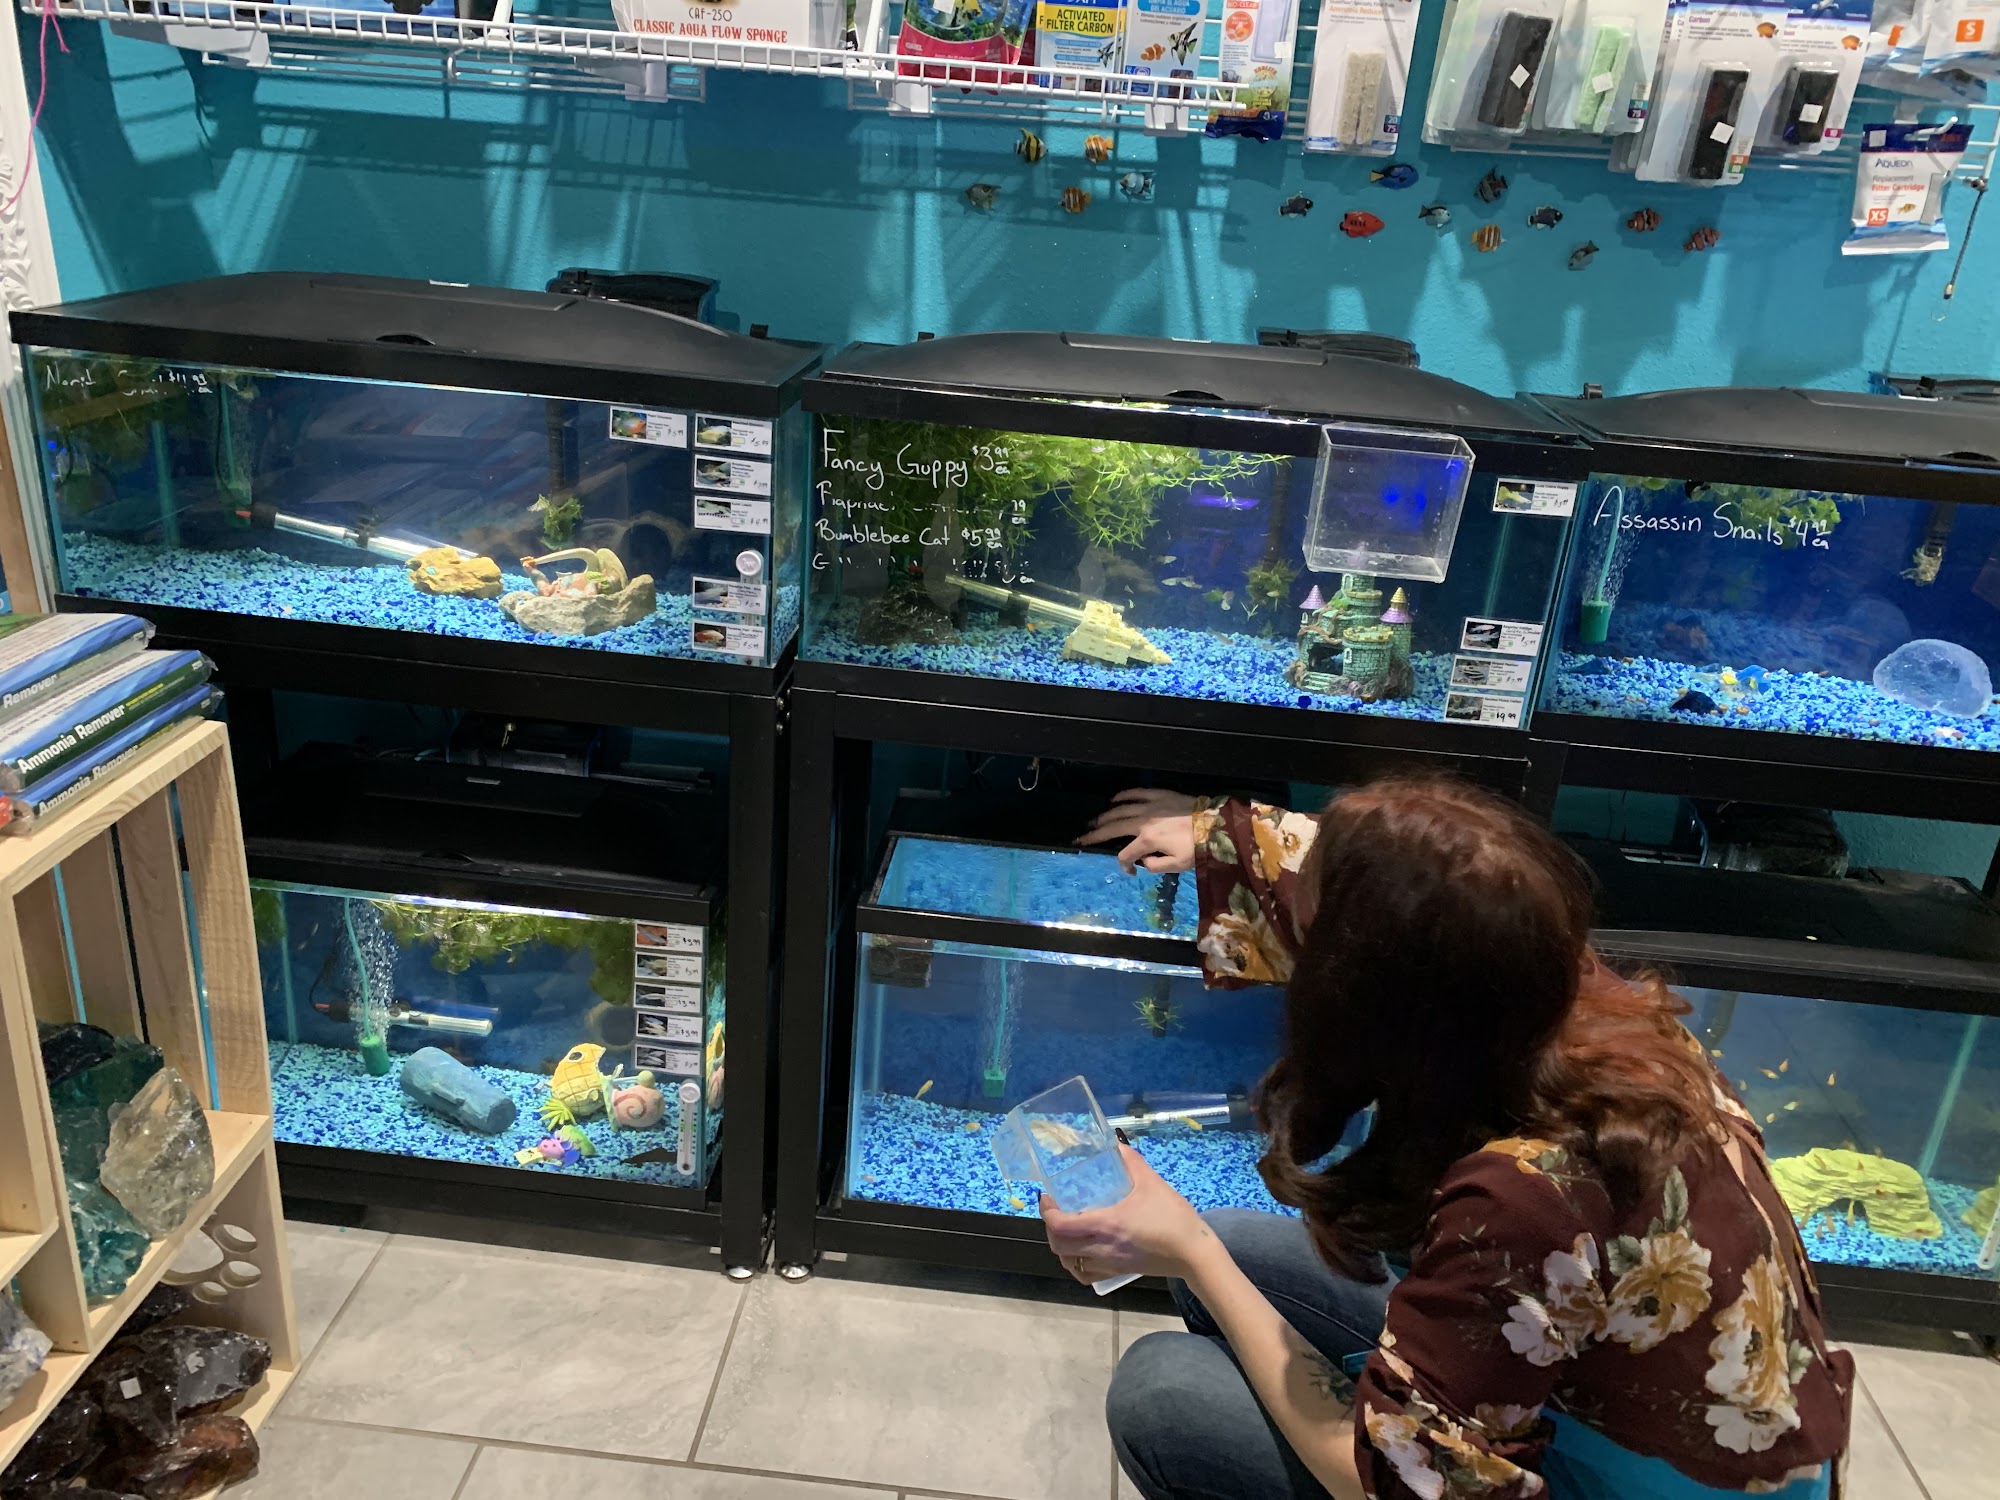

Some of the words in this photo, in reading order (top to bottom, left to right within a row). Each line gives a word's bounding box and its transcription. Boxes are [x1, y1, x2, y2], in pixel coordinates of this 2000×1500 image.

[688, 7, 733, 23] CAF-250
[1057, 9, 1106, 22] ACTIVATED
[633, 18, 676, 35] CLASSIC
[679, 22, 708, 38] AQUA
[711, 25, 742, 40] FLOW
[746, 28, 788, 44] SPONGE
[1046, 19, 1075, 31] FILTER
[1077, 21, 1114, 34] CARBON
[1387, 124, 1397, 133] 75
[1388, 116, 1398, 125] 20
[1872, 174, 1915, 184] Replacement
[1871, 183, 1891, 192] Filter
[1892, 183, 1926, 193] Cartridge
[1870, 209, 1887, 220] XS
[822, 427, 885, 491] Fancy
[896, 442, 969, 489] Guppy
[1593, 485, 1702, 534] Assassin
[1712, 502, 1784, 547] Snails
[815, 518, 911, 543] Bumblebee
[918, 525, 951, 546] Cat
[2, 673, 58, 709] Remover
[17, 731, 77, 774] Ammonia
[74, 704, 126, 740] Remover
[38, 776, 93, 817] Ammonia
[91, 743, 140, 782] Remover
